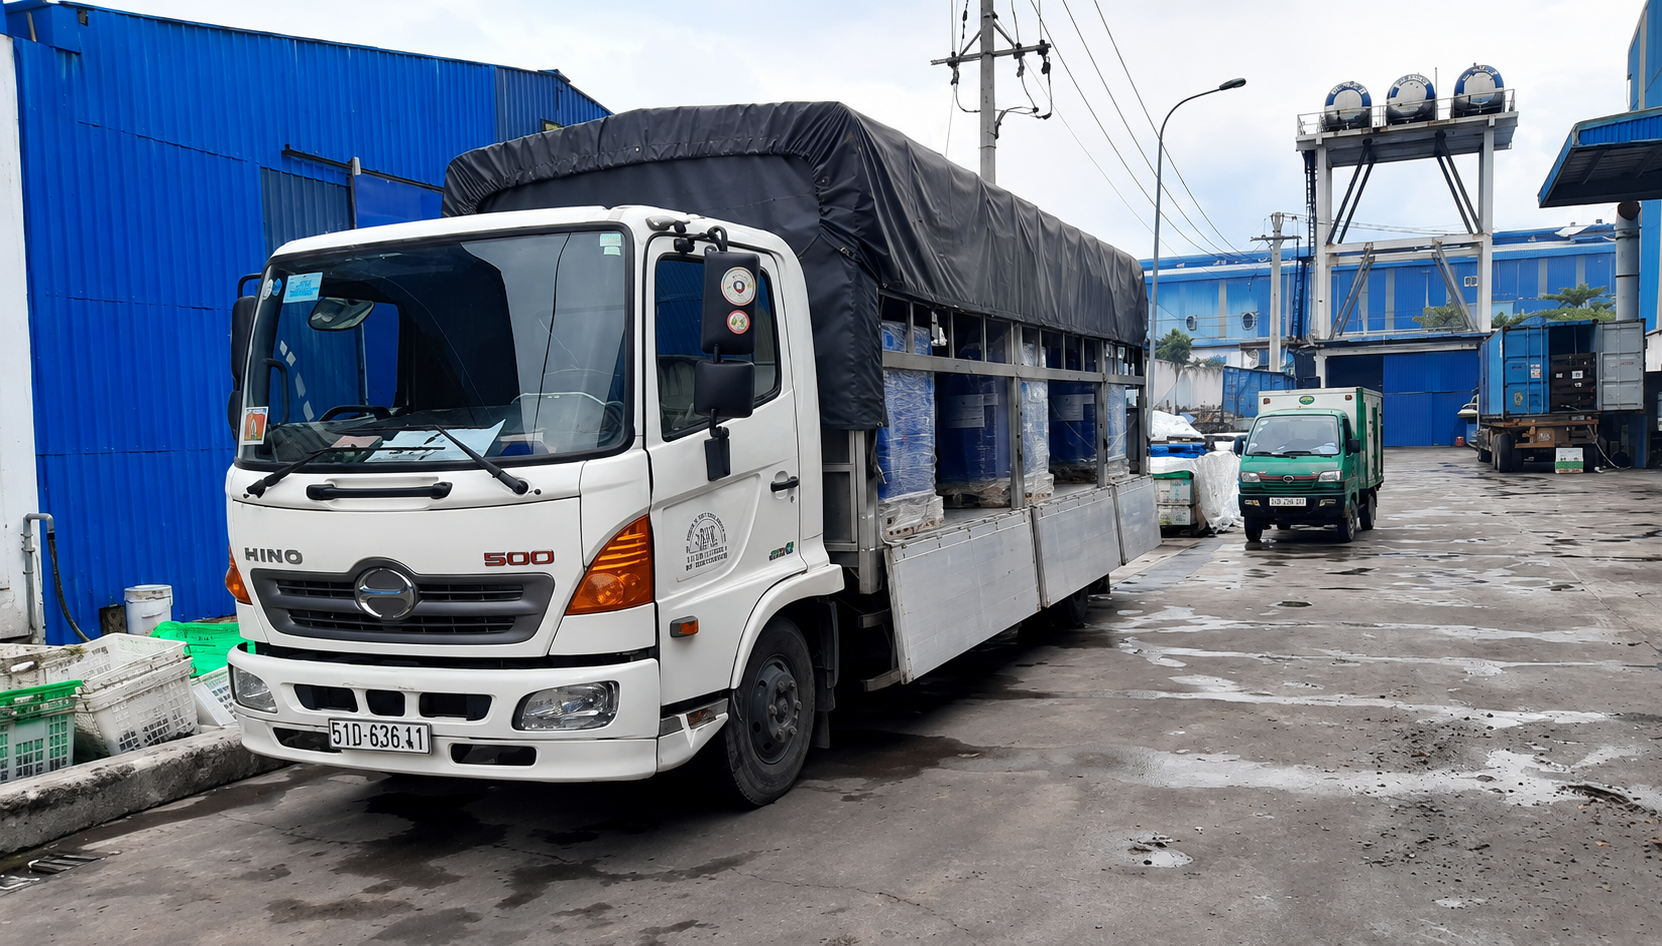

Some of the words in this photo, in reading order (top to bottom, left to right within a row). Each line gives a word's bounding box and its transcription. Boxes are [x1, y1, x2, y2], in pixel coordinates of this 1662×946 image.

[244, 547, 303, 565] HINO
[484, 550, 555, 567] 500
[331, 721, 423, 750] 51D-636.11
